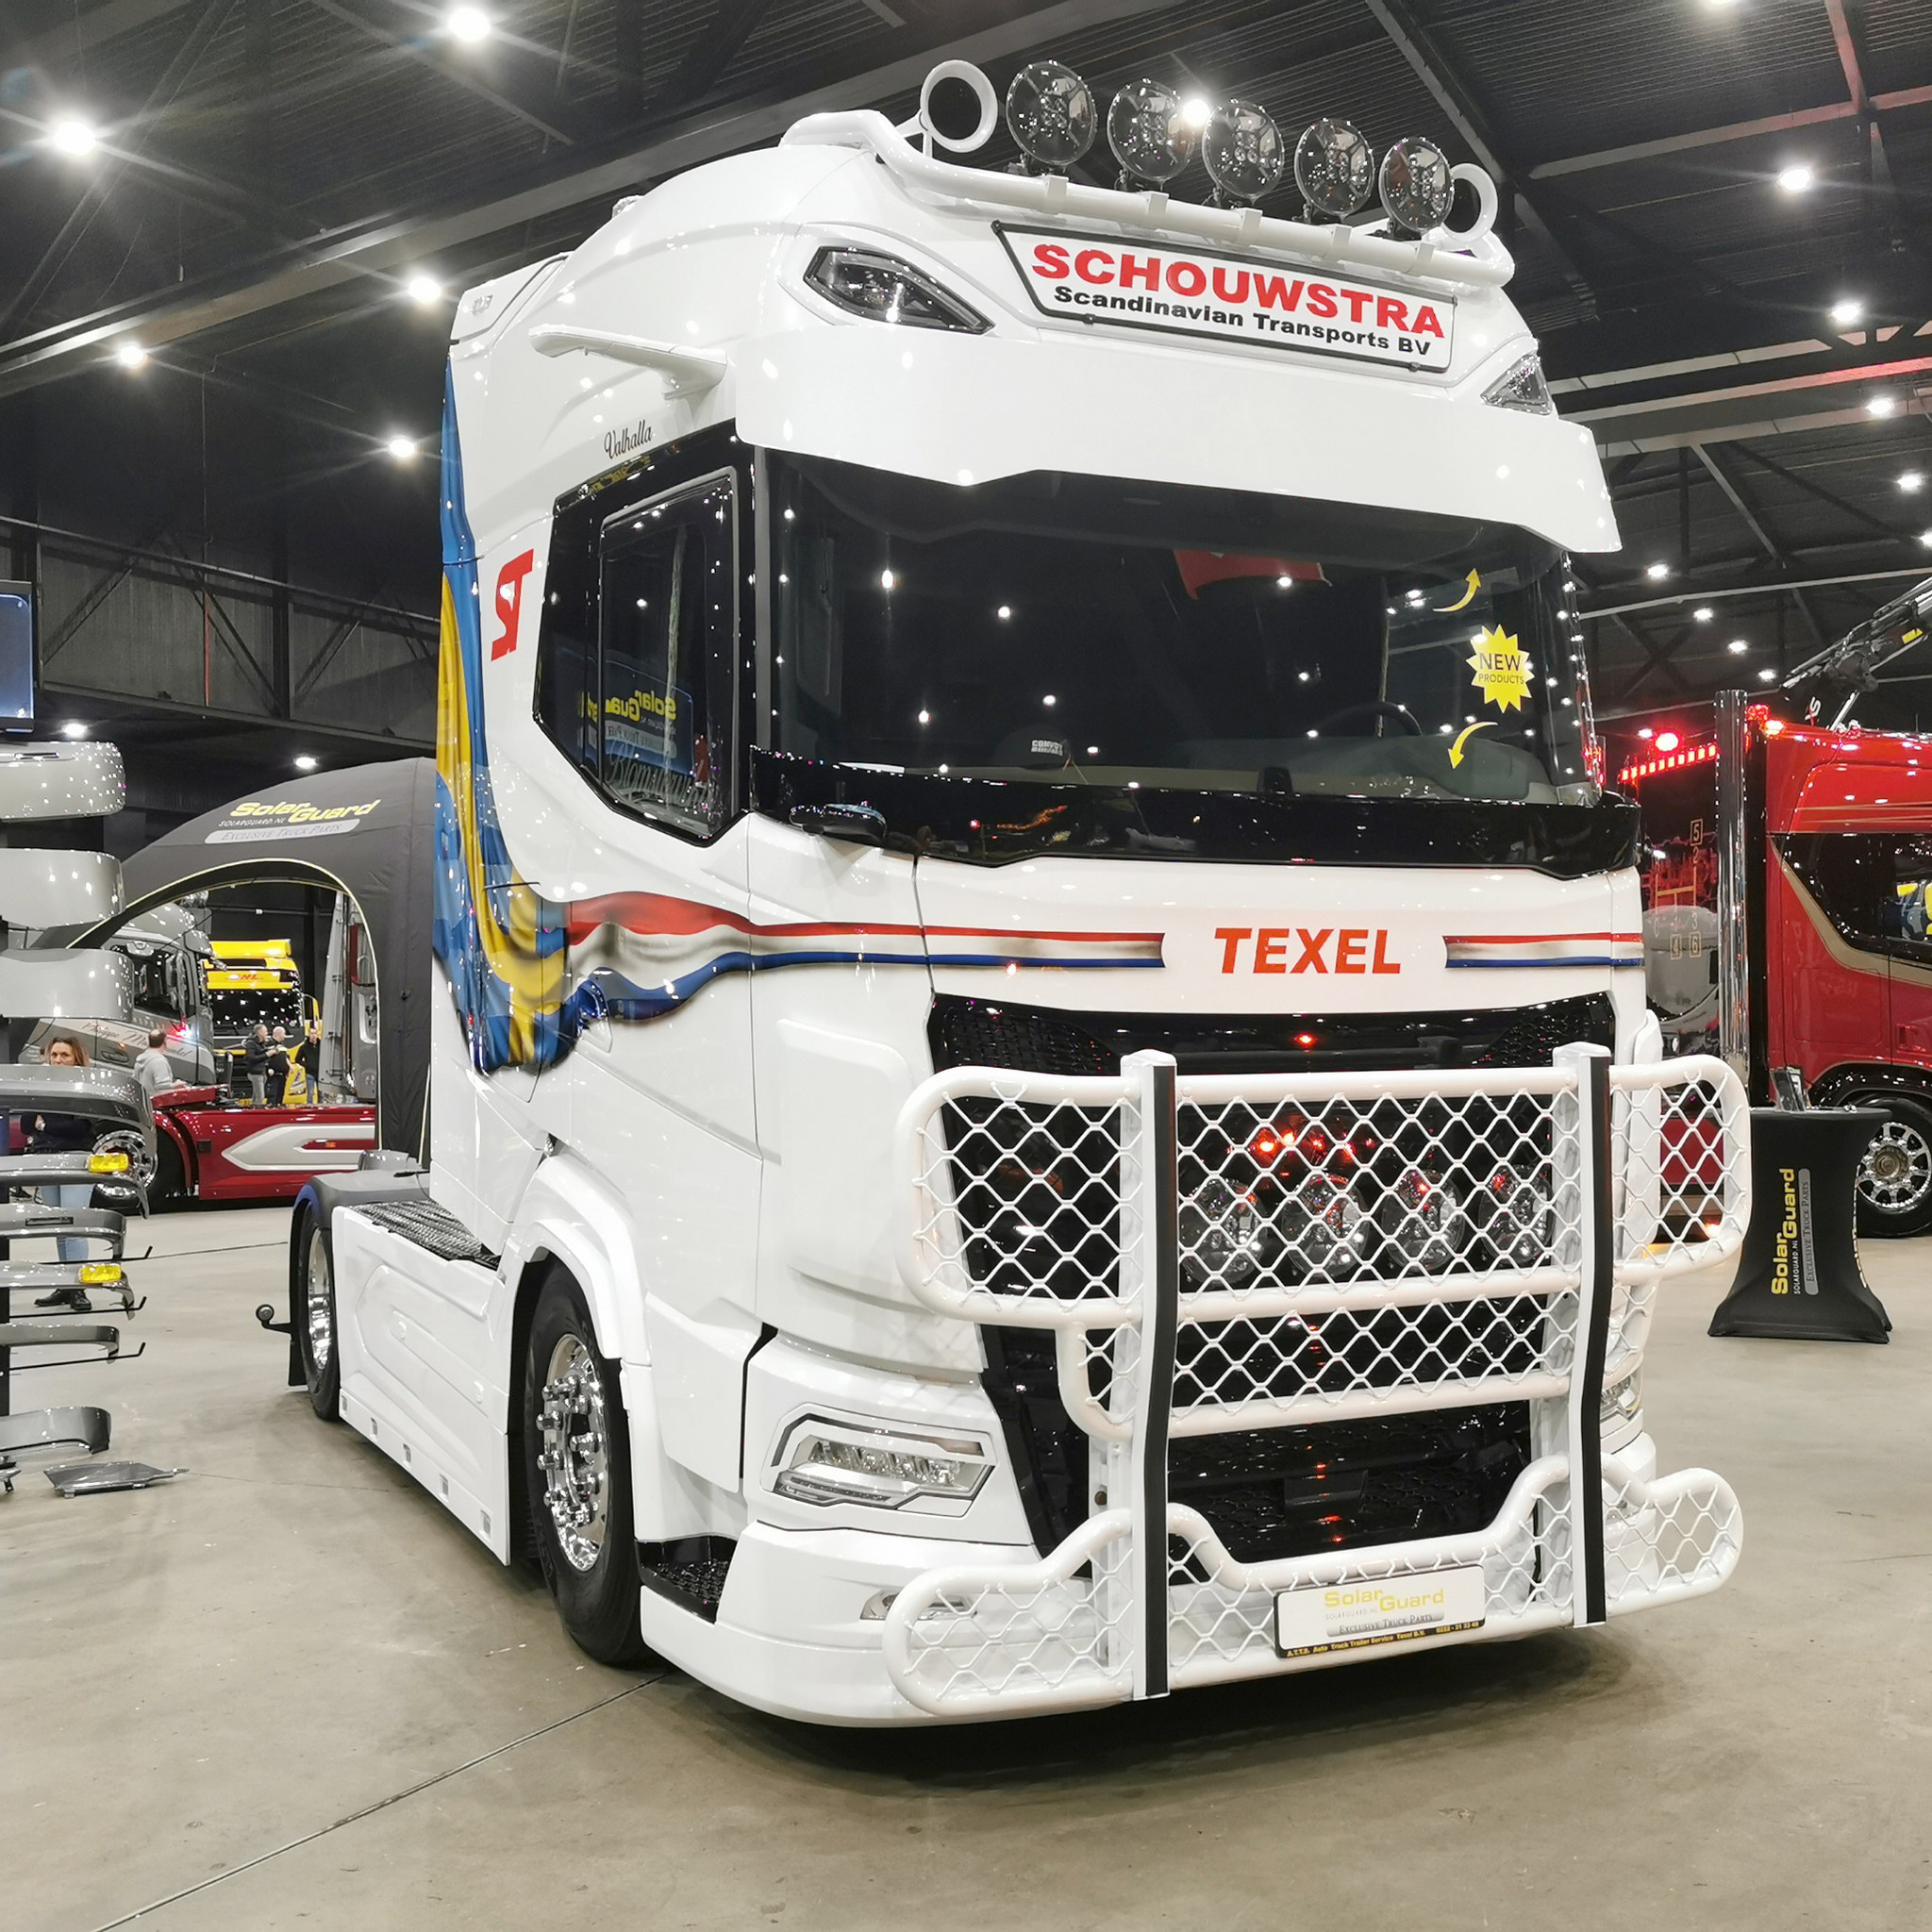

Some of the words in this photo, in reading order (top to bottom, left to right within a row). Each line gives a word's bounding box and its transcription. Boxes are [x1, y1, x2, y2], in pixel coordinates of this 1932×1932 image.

[1033, 242, 1445, 339] SCHOUWSTRA
[1054, 285, 1244, 327] Scandinavian
[1253, 312, 1390, 349] Transports
[1398, 337, 1431, 356] BV
[604, 419, 652, 459] Valhalla
[1479, 652, 1521, 672] NEW
[1478, 674, 1524, 685] PRODUCTS
[1214, 927, 1402, 974] TEXEL
[1801, 1181, 1810, 1208] PARTS
[1802, 1210, 1812, 1238] TRUCK
[1805, 1239, 1816, 1283] EXCLUSIVE
[1339, 1620, 1381, 1635] EXCLUSIVE
[1381, 1617, 1409, 1629] TRUCK
[1409, 1613, 1434, 1625] PARTS
[1330, 1641, 1350, 1651] Truck
[1350, 1638, 1371, 1648] Trailer
